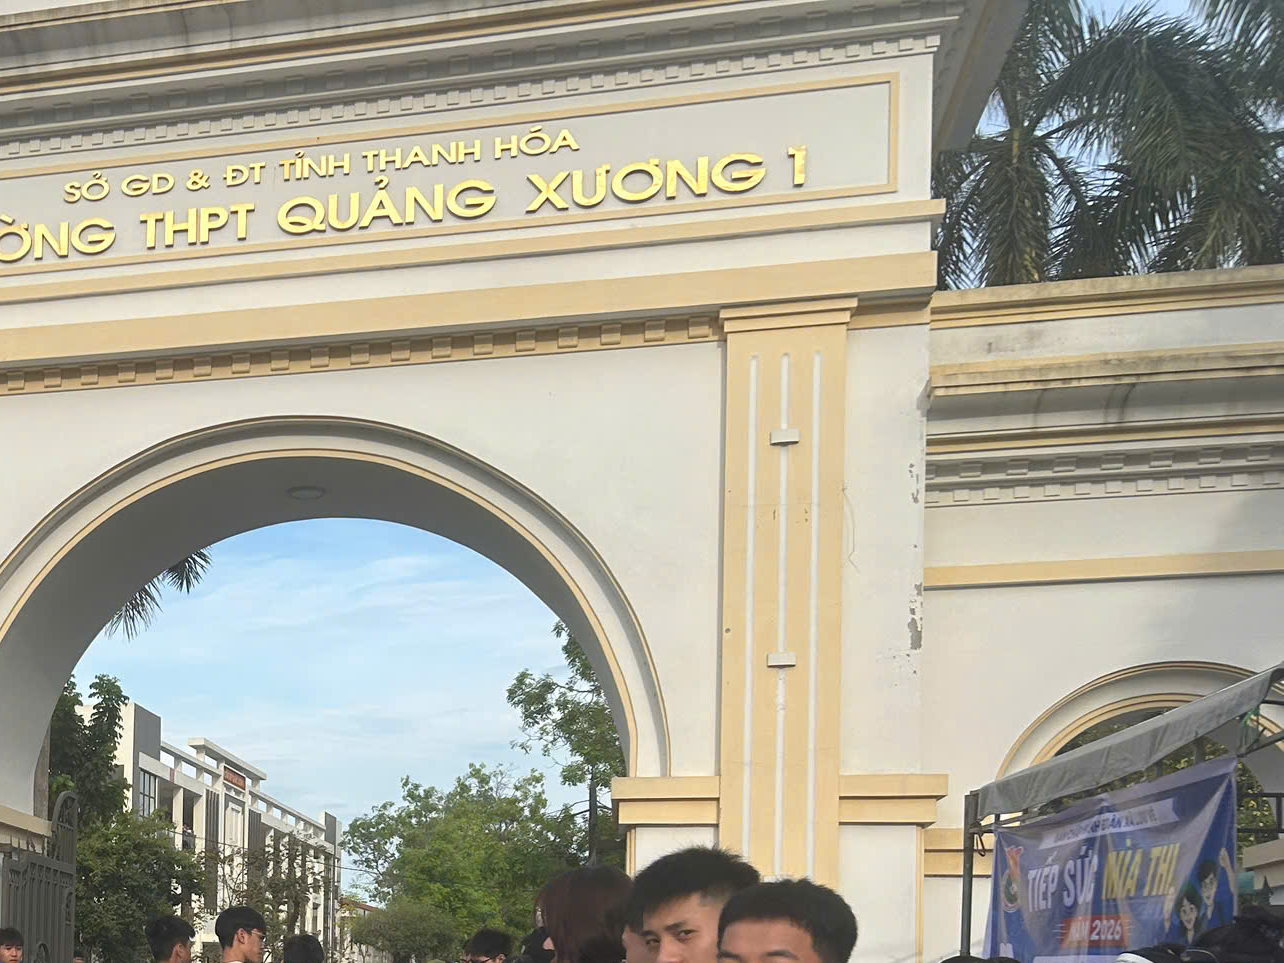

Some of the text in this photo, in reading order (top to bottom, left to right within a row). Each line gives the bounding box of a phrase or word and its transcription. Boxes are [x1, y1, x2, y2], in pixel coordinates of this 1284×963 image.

[64, 125, 580, 203] SỞ GD & ĐT TỈNH THANH HÓA
[140, 202, 256, 249] THPT
[277, 175, 497, 235] QUẢNG
[525, 152, 766, 214] XƯƠNG
[788, 146, 807, 188] 1
[1028, 851, 1060, 913] TIẾP
[1062, 845, 1099, 908] SỨC
[1090, 919, 1122, 941] 2026
